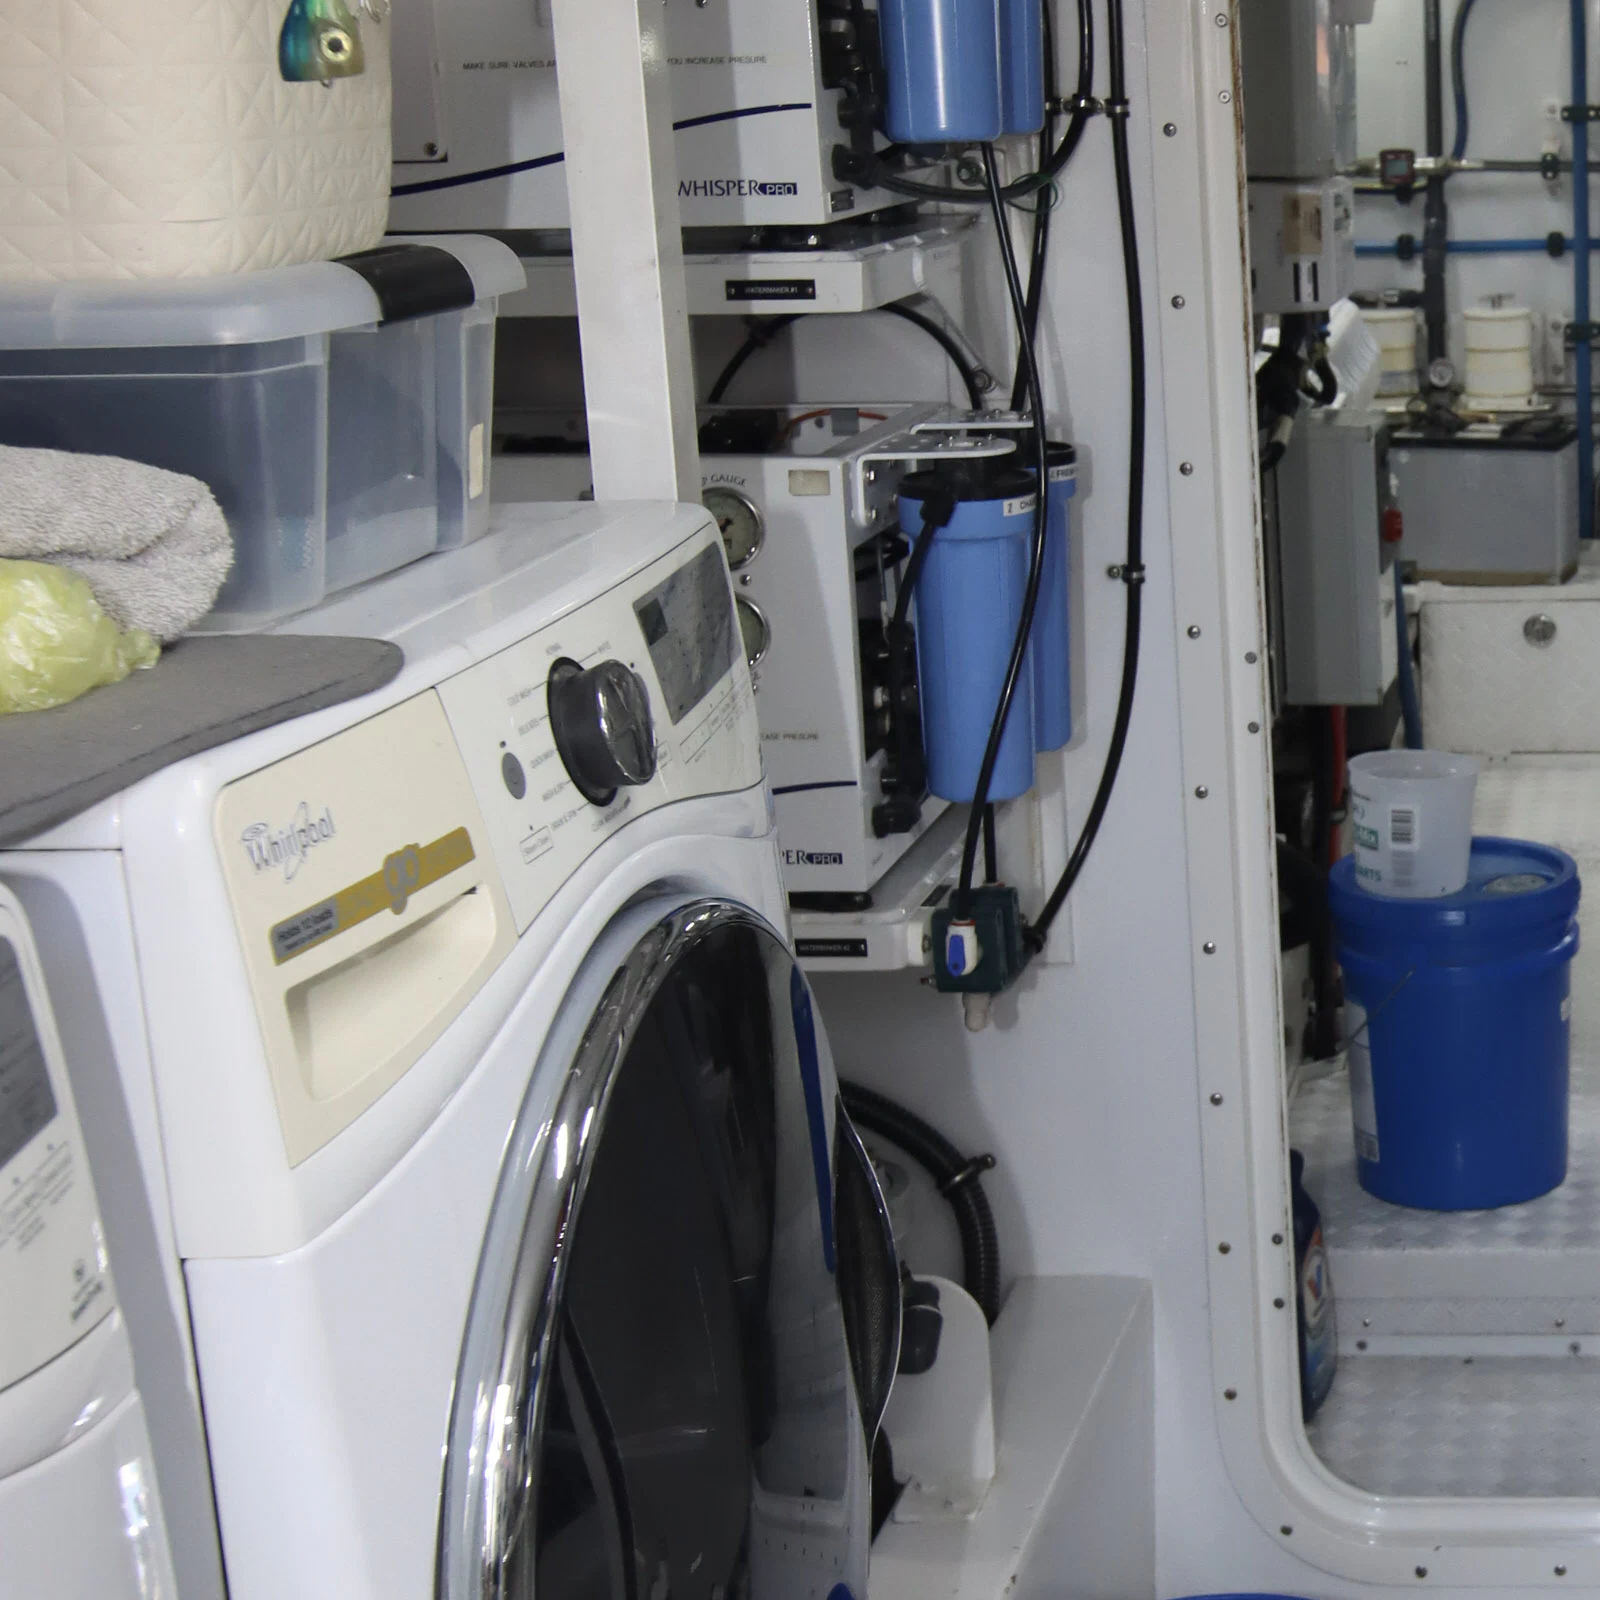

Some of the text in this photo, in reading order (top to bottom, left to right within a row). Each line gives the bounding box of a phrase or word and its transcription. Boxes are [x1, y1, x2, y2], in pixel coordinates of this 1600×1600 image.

[462, 60, 545, 70] MAKE SURE VALVES
[765, 183, 796, 195] PRO
[240, 800, 337, 885] Whirlpool
[812, 854, 841, 865] PRO
